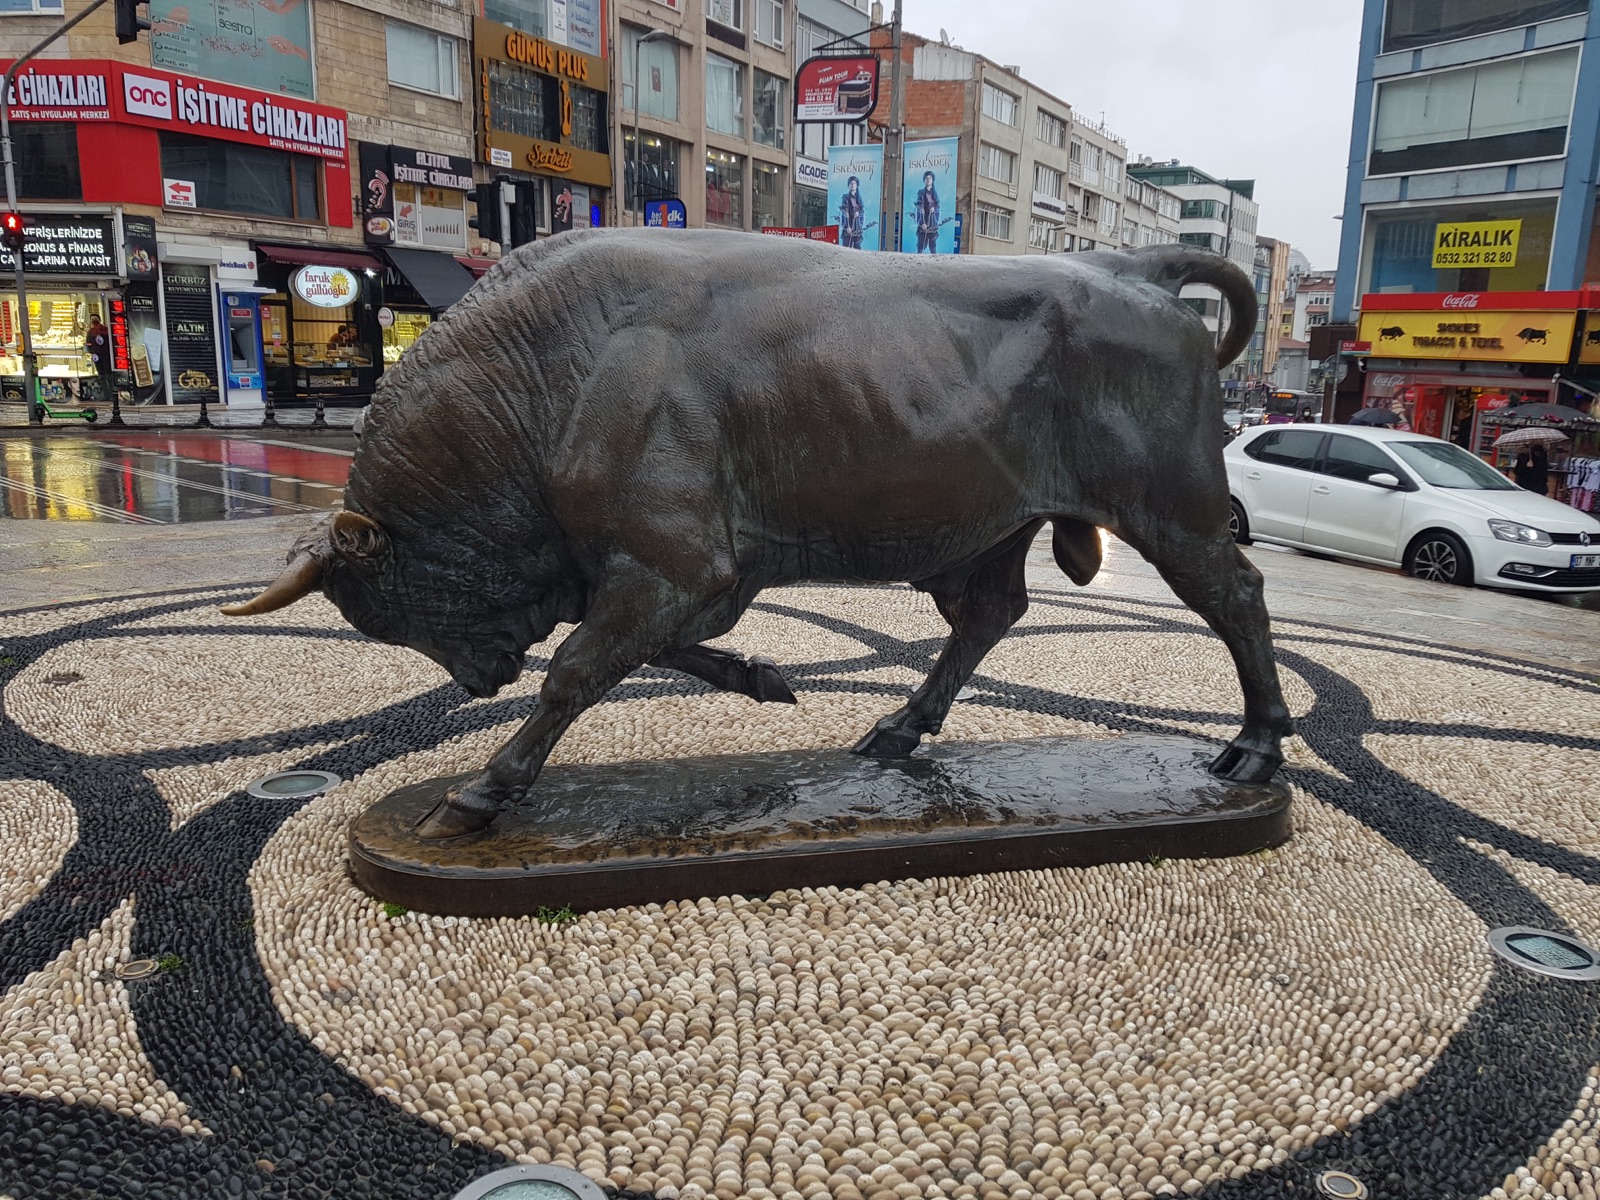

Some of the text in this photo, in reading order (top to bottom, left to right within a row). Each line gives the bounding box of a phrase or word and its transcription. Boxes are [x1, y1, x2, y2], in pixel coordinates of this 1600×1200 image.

[506, 31, 589, 80] GÜMÜŞ PLUS
[18, 67, 107, 106] CİHAZLARI
[129, 85, 168, 107] onc
[11, 109, 30, 120] SATIŞ
[40, 110, 78, 119] UYGULAMA
[79, 109, 110, 119] MERKEZİ
[176, 79, 346, 149] İŞİTME CİHAZLARI
[481, 57, 491, 161] TOBACCO
[269, 138, 285, 149] SATIŞ
[292, 142, 321, 154] UYGULAMA
[322, 147, 344, 158] MERKEZİ
[1439, 228, 1514, 248] KİRALIK
[58, 244, 66, 253] &
[68, 241, 104, 254] FİNANS
[1436, 251, 1512, 264] 0532 321 82 80
[167, 274, 207, 286] GÜRBÜZ
[304, 270, 331, 283] faruk
[305, 283, 350, 298] güllüoğlu
[176, 323, 205, 333] ALTIN
